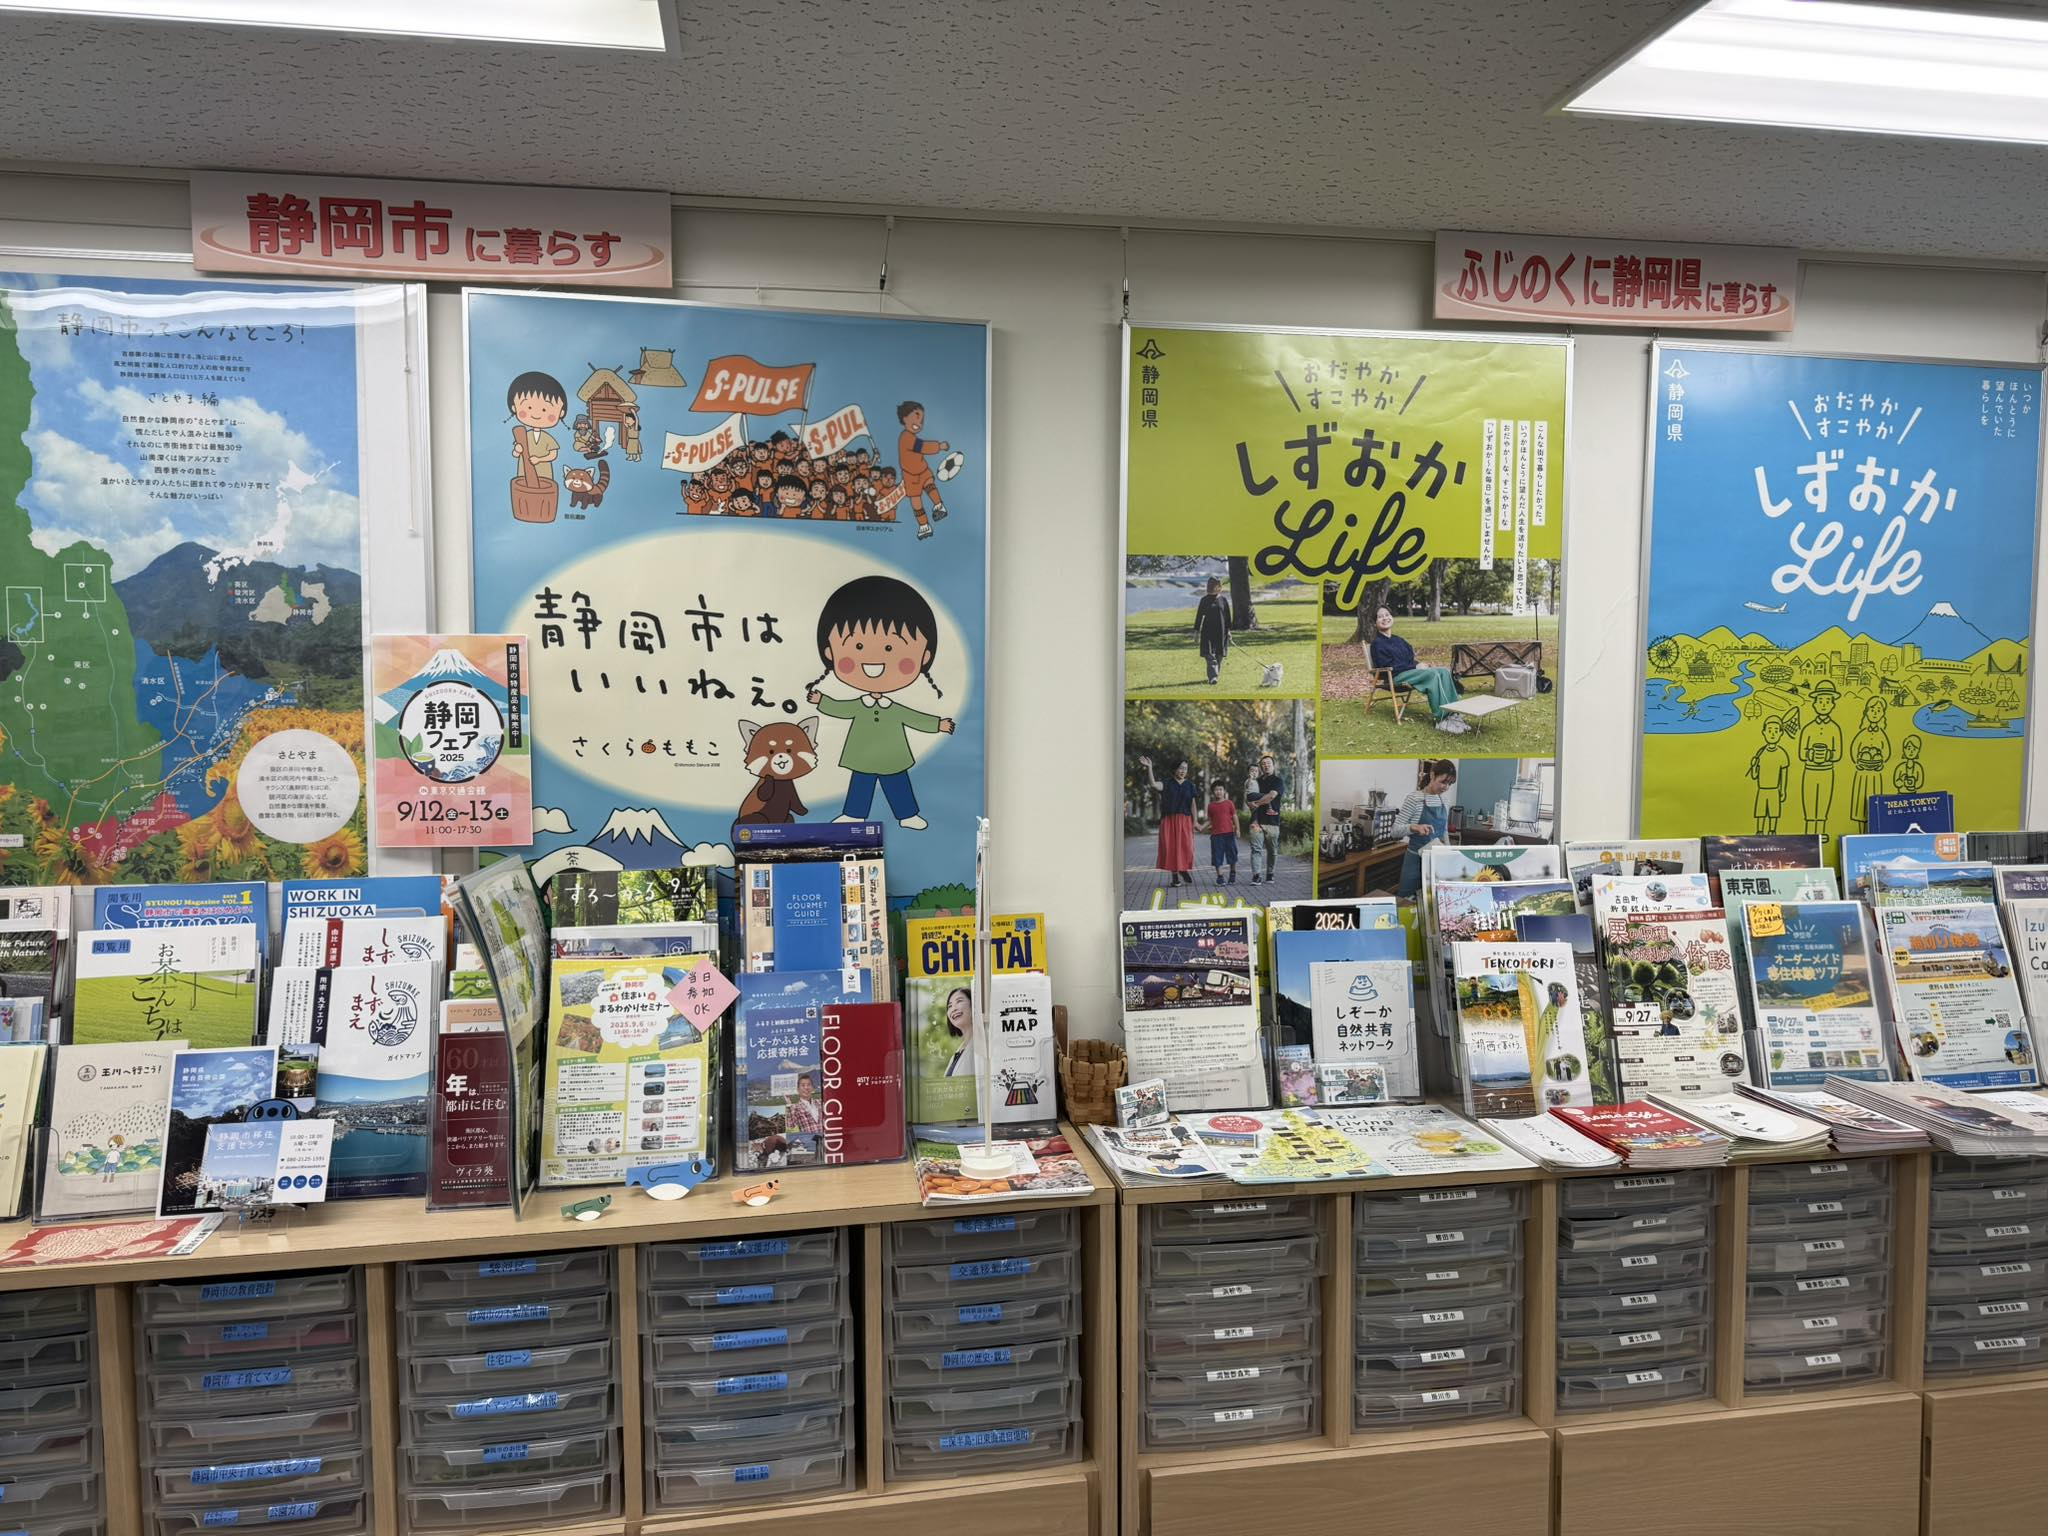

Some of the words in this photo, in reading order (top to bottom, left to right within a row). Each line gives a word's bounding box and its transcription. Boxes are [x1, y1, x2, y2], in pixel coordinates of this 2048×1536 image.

[246, 192, 622, 267] 静岡市に暮らす
[1457, 249, 1777, 316] ふじのくに静岡県に暮らす
[1304, 360, 1400, 384] おだやか
[706, 369, 801, 405] S-PULSE
[1141, 364, 1160, 428] 静岡県
[1307, 387, 1394, 410] すこやか
[1814, 392, 1898, 414] おだやか
[1981, 379, 1991, 426] 暮らしを
[2022, 383, 2032, 415] いつか
[1667, 383, 1685, 442] 静岡県
[1993, 380, 2005, 438] 望んでいた
[2008, 381, 2018, 438] ほんとうに
[1817, 416, 1893, 439] すこやか
[672, 426, 735, 465] S-PULSE
[1236, 422, 1466, 499] しずおか
[1755, 449, 1957, 523] しずおか
[1254, 492, 1428, 603] Life
[1772, 516, 1924, 621] Life
[535, 587, 783, 653] 静岡市は
[425, 689, 457, 700] SHIZUOKA
[459, 689, 476, 700] FAIR
[424, 701, 479, 730] 静岡
[427, 731, 480, 751] フェア
[575, 738, 634, 758] さくら
[663, 740, 720, 757] ももこ
[278, 751, 317, 760] さとやま
[440, 754, 464, 762] 2025
[431, 786, 486, 796] 東京交通会館
[566, 852, 579, 866] 茶
[671, 877, 680, 893] 9
[240, 891, 253, 905] 1
[289, 890, 337, 902] WORK
[343, 889, 359, 901] IN
[792, 893, 821, 901] FLOOR
[1615, 895, 1638, 904] 吉田町
[289, 905, 375, 918] SHIZUOKA
[787, 901, 828, 910] GOURMET
[2025, 918, 2045, 932] Izu
[397, 934, 435, 952] SHIZUMAE
[922, 930, 1033, 975] CHITAI
[1774, 954, 1840, 965] オーダーメイド
[1481, 956, 1554, 970] TENCOMORI
[688, 972, 712, 984] 当日
[385, 980, 421, 998] SHIZUMAE
[621, 991, 647, 1000] 住まい
[686, 986, 715, 1000] 参加
[599, 1002, 670, 1014] まるわかりセミナー
[694, 1004, 711, 1016] OK
[1337, 1005, 1392, 1020] しぞーか
[1625, 1010, 1651, 1023] 9/27
[1777, 1016, 1797, 1028] 9/27
[1002, 1018, 1038, 1032] MAP
[1337, 1022, 1393, 1037] 自然共育
[750, 1033, 816, 1048] しぞーかふるさと
[1339, 1040, 1394, 1052] ネットワーク
[388, 1051, 422, 1062] ガイドマップ
[757, 1046, 809, 1059] 応援寄附金
[822, 1014, 842, 1089] FLOOR
[101, 1064, 163, 1078] 玉川へ行こう!
[823, 1099, 843, 1163] GUIDE
[1335, 1119, 1394, 1128] Living
[456, 1165, 494, 1177] ヴィラ葵
[487, 1353, 530, 1367] 住宅ローン
[203, 1374, 231, 1388] 静岡市
